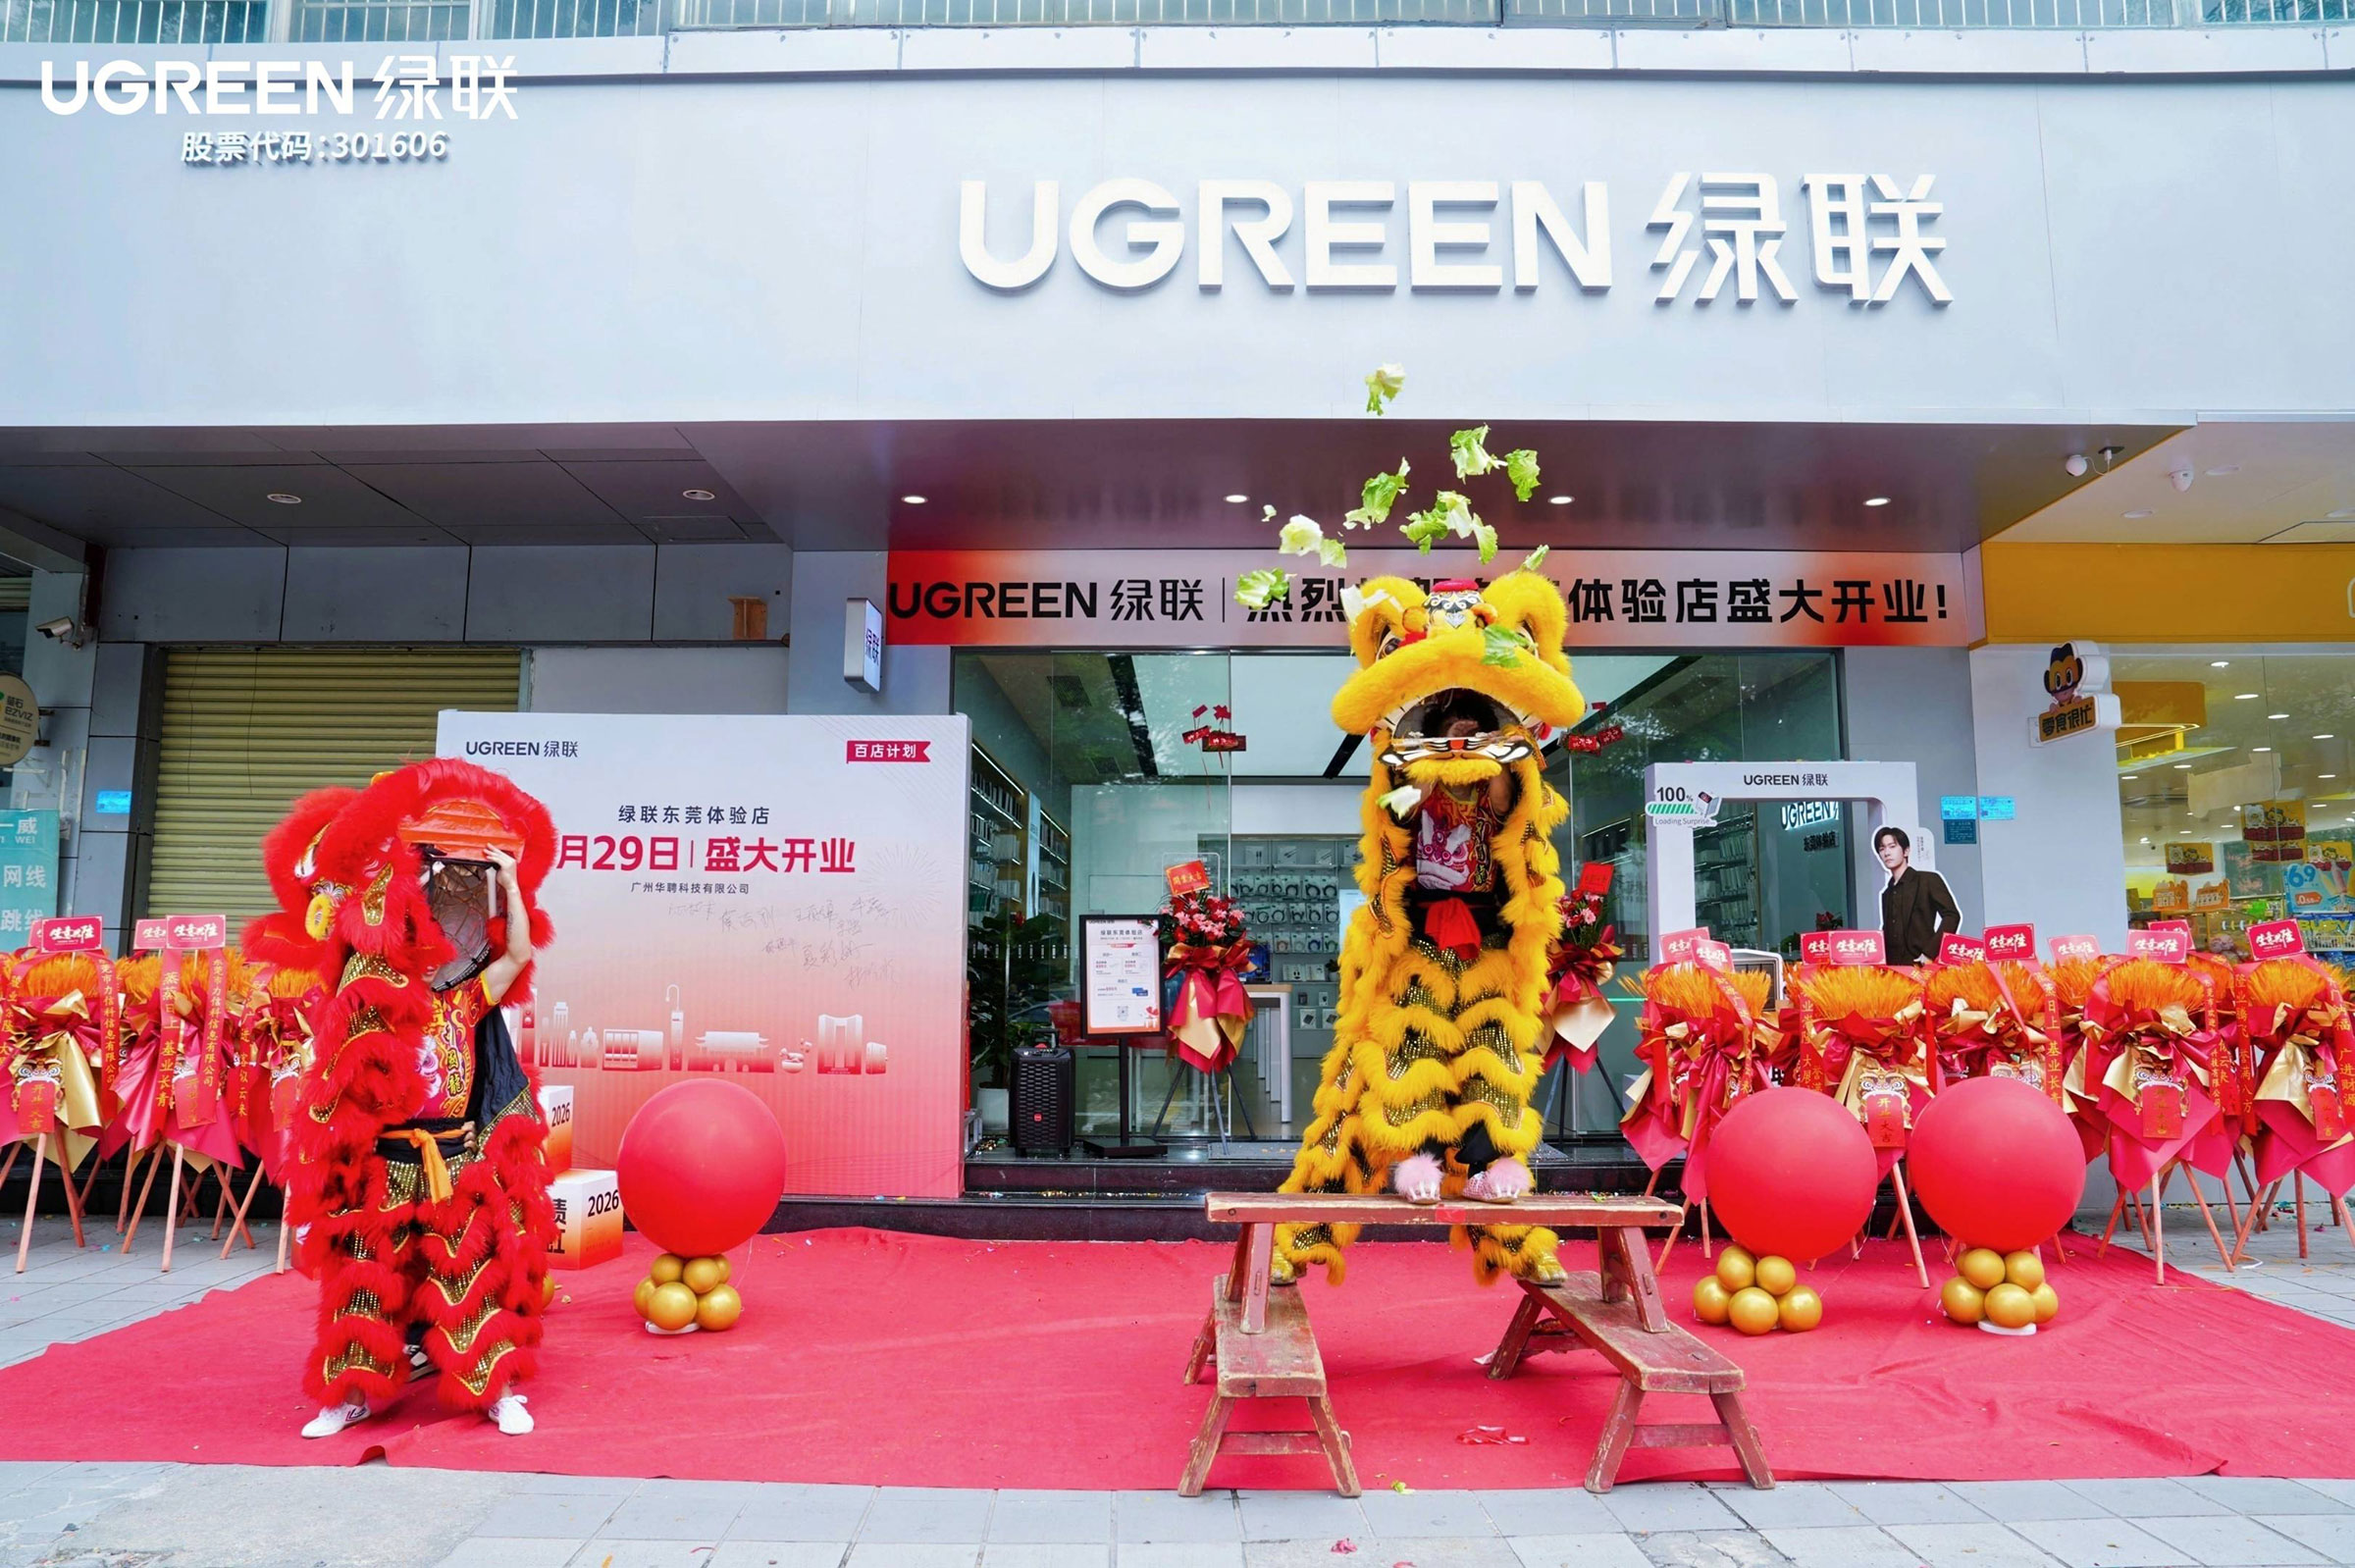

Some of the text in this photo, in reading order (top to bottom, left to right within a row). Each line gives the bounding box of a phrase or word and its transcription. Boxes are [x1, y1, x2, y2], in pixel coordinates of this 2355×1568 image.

[958, 170, 1953, 307] UGREEN 绿联
[887, 577, 1949, 625] UGREEN 绿联 热烈体验店盛大开业!
[2043, 704, 2092, 737] 零食很忙
[465, 740, 579, 758] UGREEN 绿联
[853, 743, 917, 759] 百店计划
[1744, 773, 1829, 786] UGREEN 绿联
[617, 805, 771, 825] 绿联东莞体验店
[1654, 817, 1682, 826] Loading
[1781, 801, 1831, 830] UGREEN
[705, 836, 856, 873] 盛大开业
[3, 864, 46, 888] 网线
[631, 881, 751, 895] 广州华聘科技有限公司
[155, 1040, 177, 1108] 基业长青
[551, 1102, 571, 1128] 2026
[1877, 1097, 1892, 1143] 开业大吉
[588, 1189, 619, 1218] 2026
